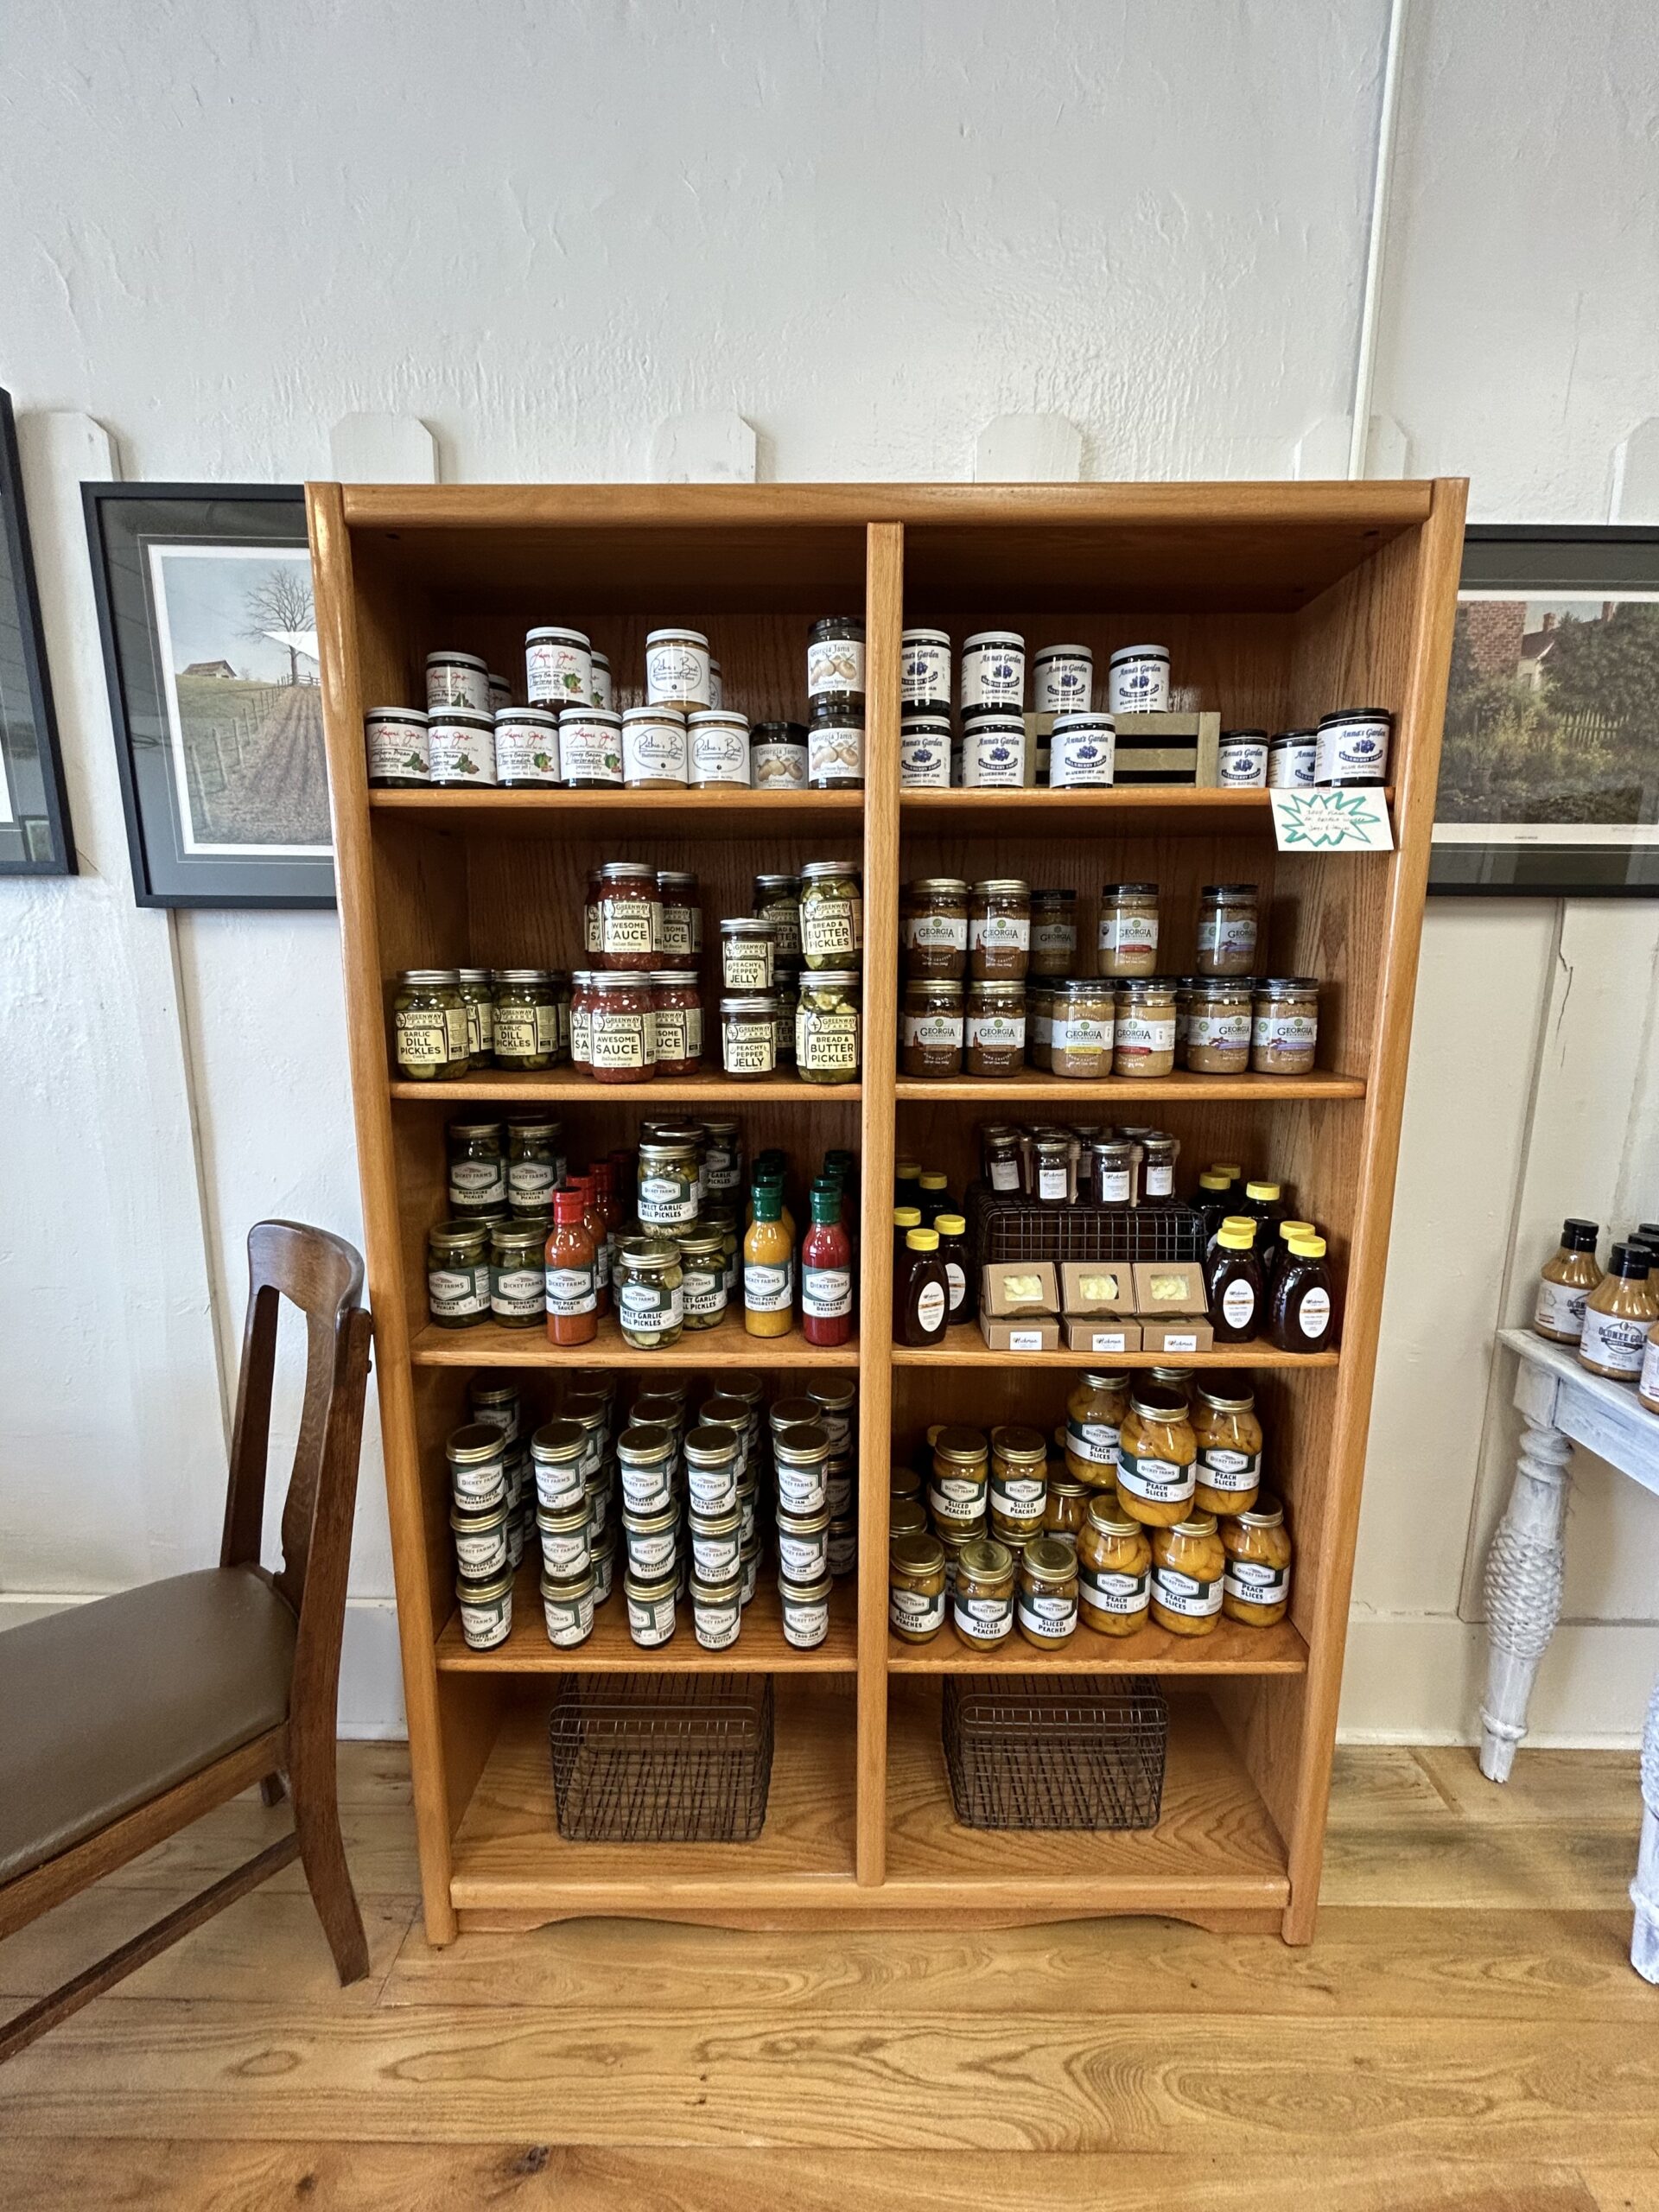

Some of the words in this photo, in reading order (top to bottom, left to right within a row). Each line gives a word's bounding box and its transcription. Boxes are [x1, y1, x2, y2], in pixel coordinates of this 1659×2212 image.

[810, 646, 831, 657] Georgia
[1069, 664, 1087, 673] Garden
[1140, 665, 1160, 674] Garden
[1339, 730, 1363, 740] Anna's
[922, 739, 942, 747] Garden
[978, 738, 998, 747] Anna's
[1001, 737, 1019, 747] Garden
[1065, 736, 1086, 746] Anna's
[1088, 734, 1108, 744] Garden
[809, 929, 849, 938] BUTTER
[918, 928, 954, 938] GEORGIA
[982, 929, 1018, 938] GEORGIA
[1119, 929, 1151, 938] GEORGIA
[810, 938, 849, 948] PICKLES
[730, 975, 758, 983] JELLY
[920, 1027, 955, 1037] GEORGIA
[980, 1027, 1014, 1037] GEORGIA
[1065, 1030, 1102, 1039] GEORGIA
[1117, 1029, 1151, 1039] GEORGIA
[1277, 1027, 1312, 1036] GEORGIA
[596, 1045, 639, 1054] SAUCE
[734, 1058, 764, 1066] JELLY
[690, 1301, 715, 1310] PICKLES
[1599, 1327, 1629, 1341] OCONEE
[1090, 1446, 1110, 1454] PEACH
[1090, 1451, 1110, 1460] SLICES
[1215, 1471, 1236, 1481] PEACH
[1147, 1482, 1168, 1491] PEACH
[1214, 1478, 1236, 1487] SLICES
[1146, 1489, 1168, 1497] SLICES
[944, 1507, 971, 1516] PEACHES
[654, 1541, 671, 1552] FARMS
[1243, 1584, 1263, 1593] PEACH
[1107, 1595, 1127, 1604] PEACH
[1166, 1593, 1186, 1604] PEACH
[1241, 1590, 1263, 1600] SLICES
[1106, 1601, 1128, 1610] SLICES
[1165, 1599, 1186, 1611] SLICES
[714, 1615, 732, 1624] FARMS
[899, 1611, 919, 1622] SLICED
[896, 1617, 922, 1628] PEACHES
[973, 1626, 1001, 1635] PEACHES
